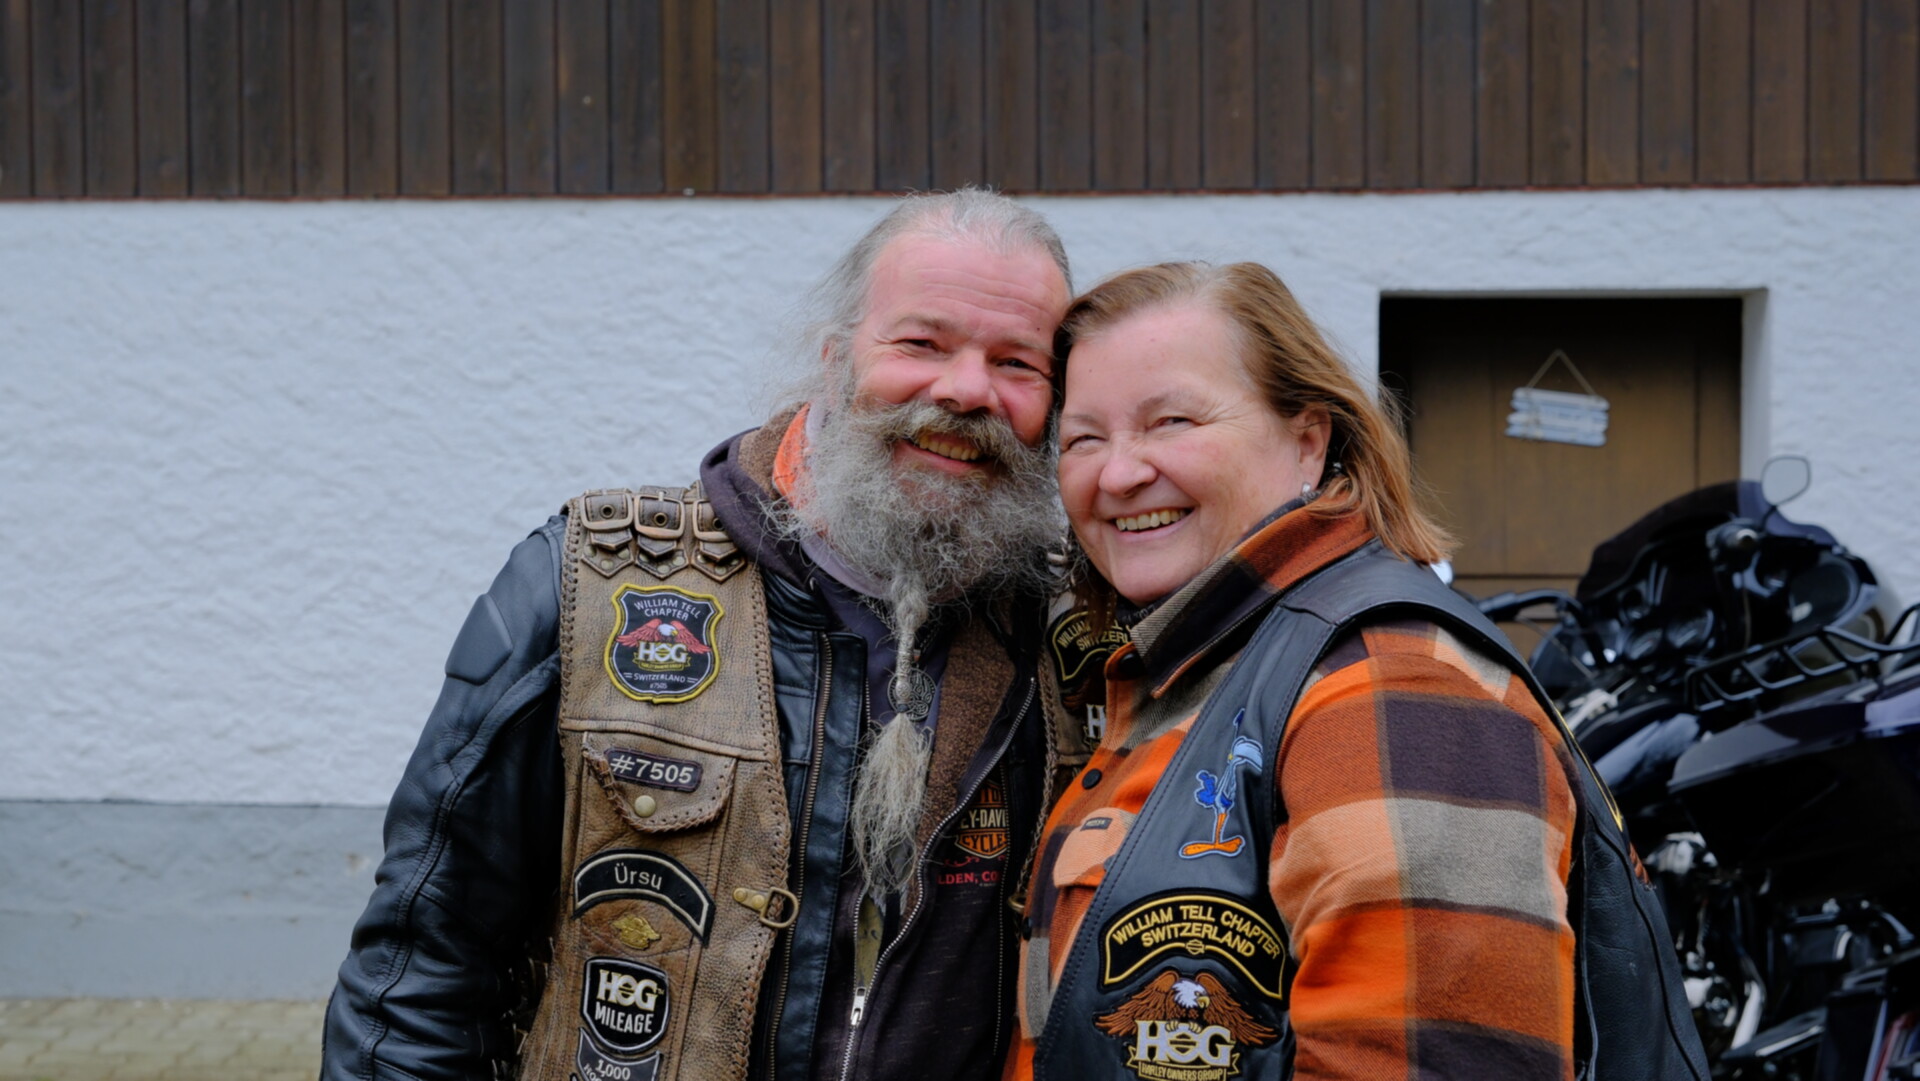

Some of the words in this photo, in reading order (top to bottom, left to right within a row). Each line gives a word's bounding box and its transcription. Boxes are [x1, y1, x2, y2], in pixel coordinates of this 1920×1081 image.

[634, 598, 678, 611] WILLIAM
[681, 602, 701, 619] TELL
[644, 608, 690, 621] CHAPTER
[638, 641, 688, 663] HOG
[633, 672, 686, 684] SWITZERLAND
[610, 754, 694, 784] #7505
[614, 862, 662, 890] Ürsu
[938, 872, 979, 885] LDEN,
[1112, 906, 1173, 946] WILLIAM
[1179, 905, 1216, 922] TELL
[1220, 910, 1281, 960] CHAPTER
[1141, 922, 1256, 958] SWITZERLAND
[596, 968, 658, 1012] HOG
[594, 1001, 654, 1034] MILEAGE
[1134, 1019, 1236, 1067] HOG
[595, 1058, 631, 1081] 1,000
[1141, 1062, 1166, 1077] HARLEY
[1167, 1067, 1197, 1081] OWNERS
[1198, 1068, 1224, 1081] GROUP
